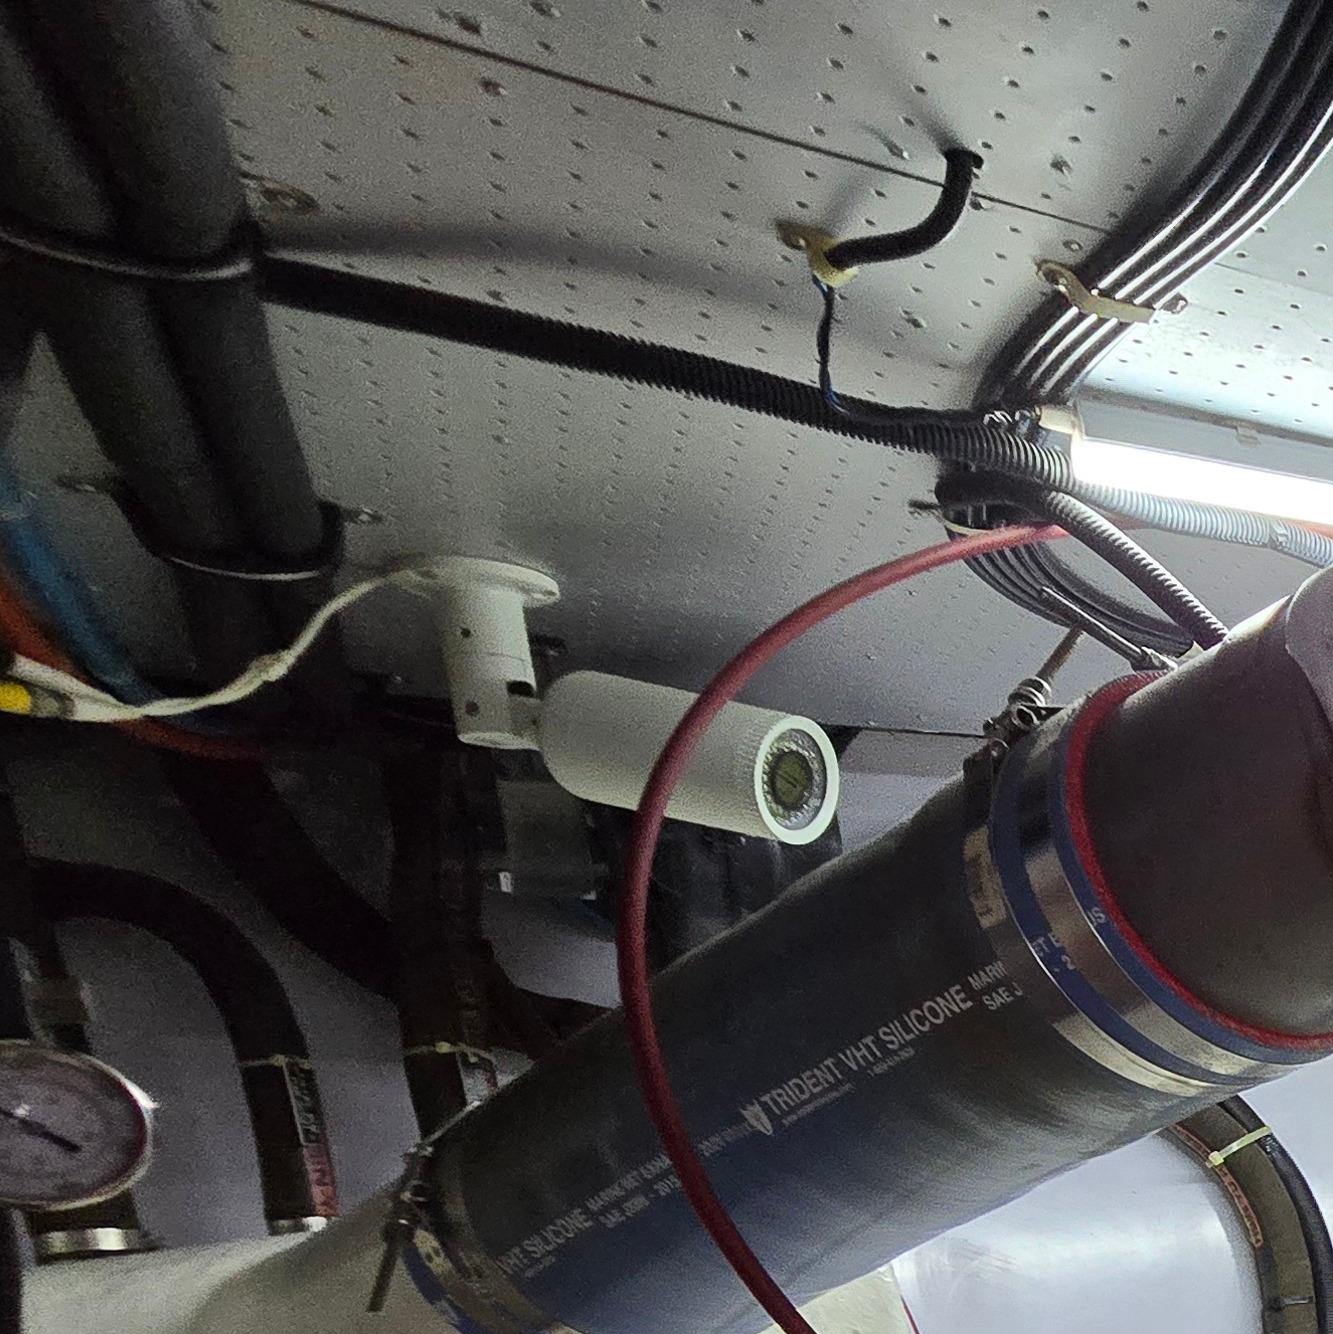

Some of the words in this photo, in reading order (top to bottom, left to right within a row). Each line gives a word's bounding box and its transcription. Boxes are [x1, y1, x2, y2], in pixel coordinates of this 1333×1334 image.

[982, 985, 1013, 1011] SAE
[761, 1057, 843, 1115] TRIDENT
[839, 1035, 882, 1071] VHT
[879, 985, 974, 1051] SILICONE
[520, 1207, 594, 1258] SILICONE
